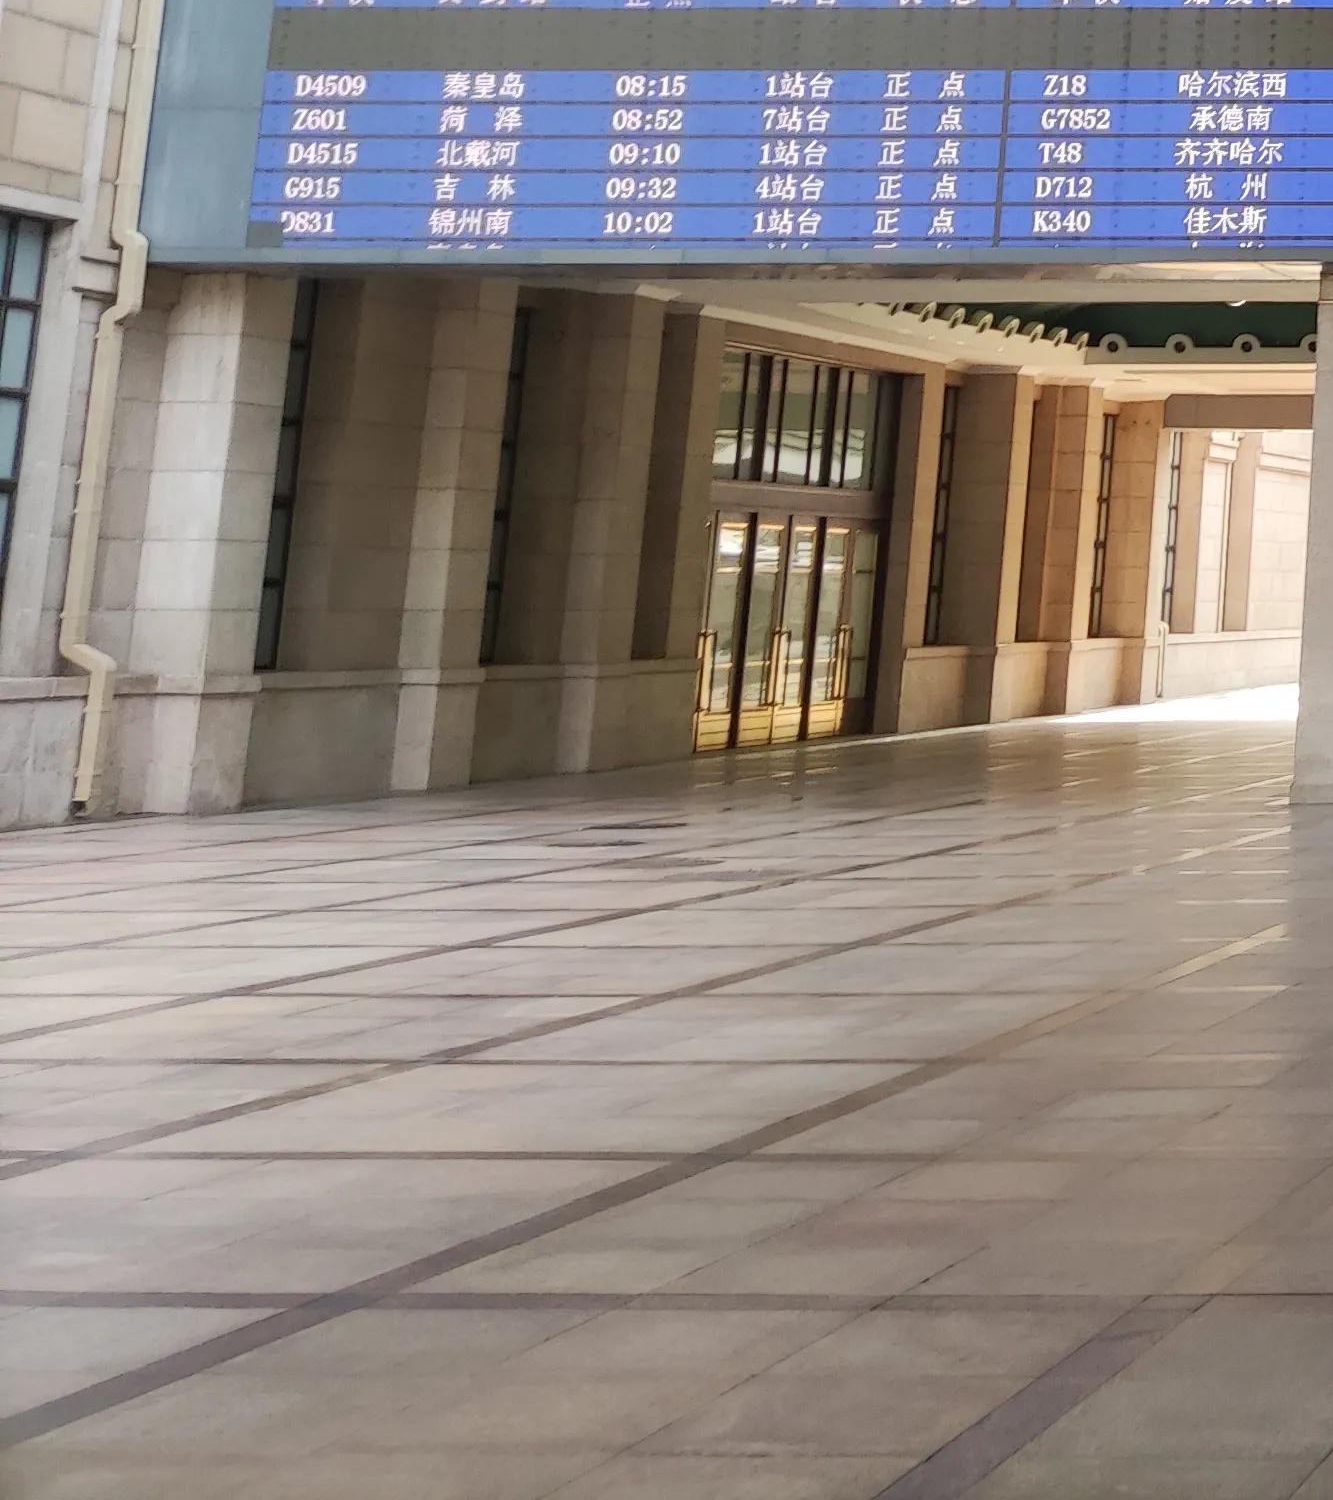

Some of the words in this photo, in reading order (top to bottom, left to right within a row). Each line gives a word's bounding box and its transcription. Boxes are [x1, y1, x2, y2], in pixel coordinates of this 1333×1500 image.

[295, 74, 366, 97] D4509
[442, 71, 525, 99] 秦皇岛
[615, 75, 687, 97] 08:15
[766, 71, 834, 99] 1站台
[1043, 74, 1087, 96] Z18
[1178, 71, 1287, 98] 哈尔滨西
[292, 108, 346, 131] Z601
[612, 108, 683, 131] 08:52
[763, 105, 831, 133] 7站台
[1041, 108, 1111, 130] G7852
[1189, 105, 1274, 132] 承德南
[287, 142, 358, 165] D4515
[436, 139, 520, 168] 北戴河
[609, 143, 681, 165] 09:10
[759, 139, 828, 167] 1站台
[1038, 141, 1082, 164] T48
[1174, 138, 1284, 166] 齐齐哈尔
[284, 176, 341, 199] G915
[606, 177, 677, 199] 09:32
[755, 173, 825, 201] 4站台
[1035, 176, 1093, 198] D712
[428, 208, 513, 236] 锦州南
[603, 211, 673, 234] 10:02
[753, 207, 822, 235] 1站台
[1032, 209, 1091, 233] K340
[1183, 206, 1268, 234] 佳木斯
